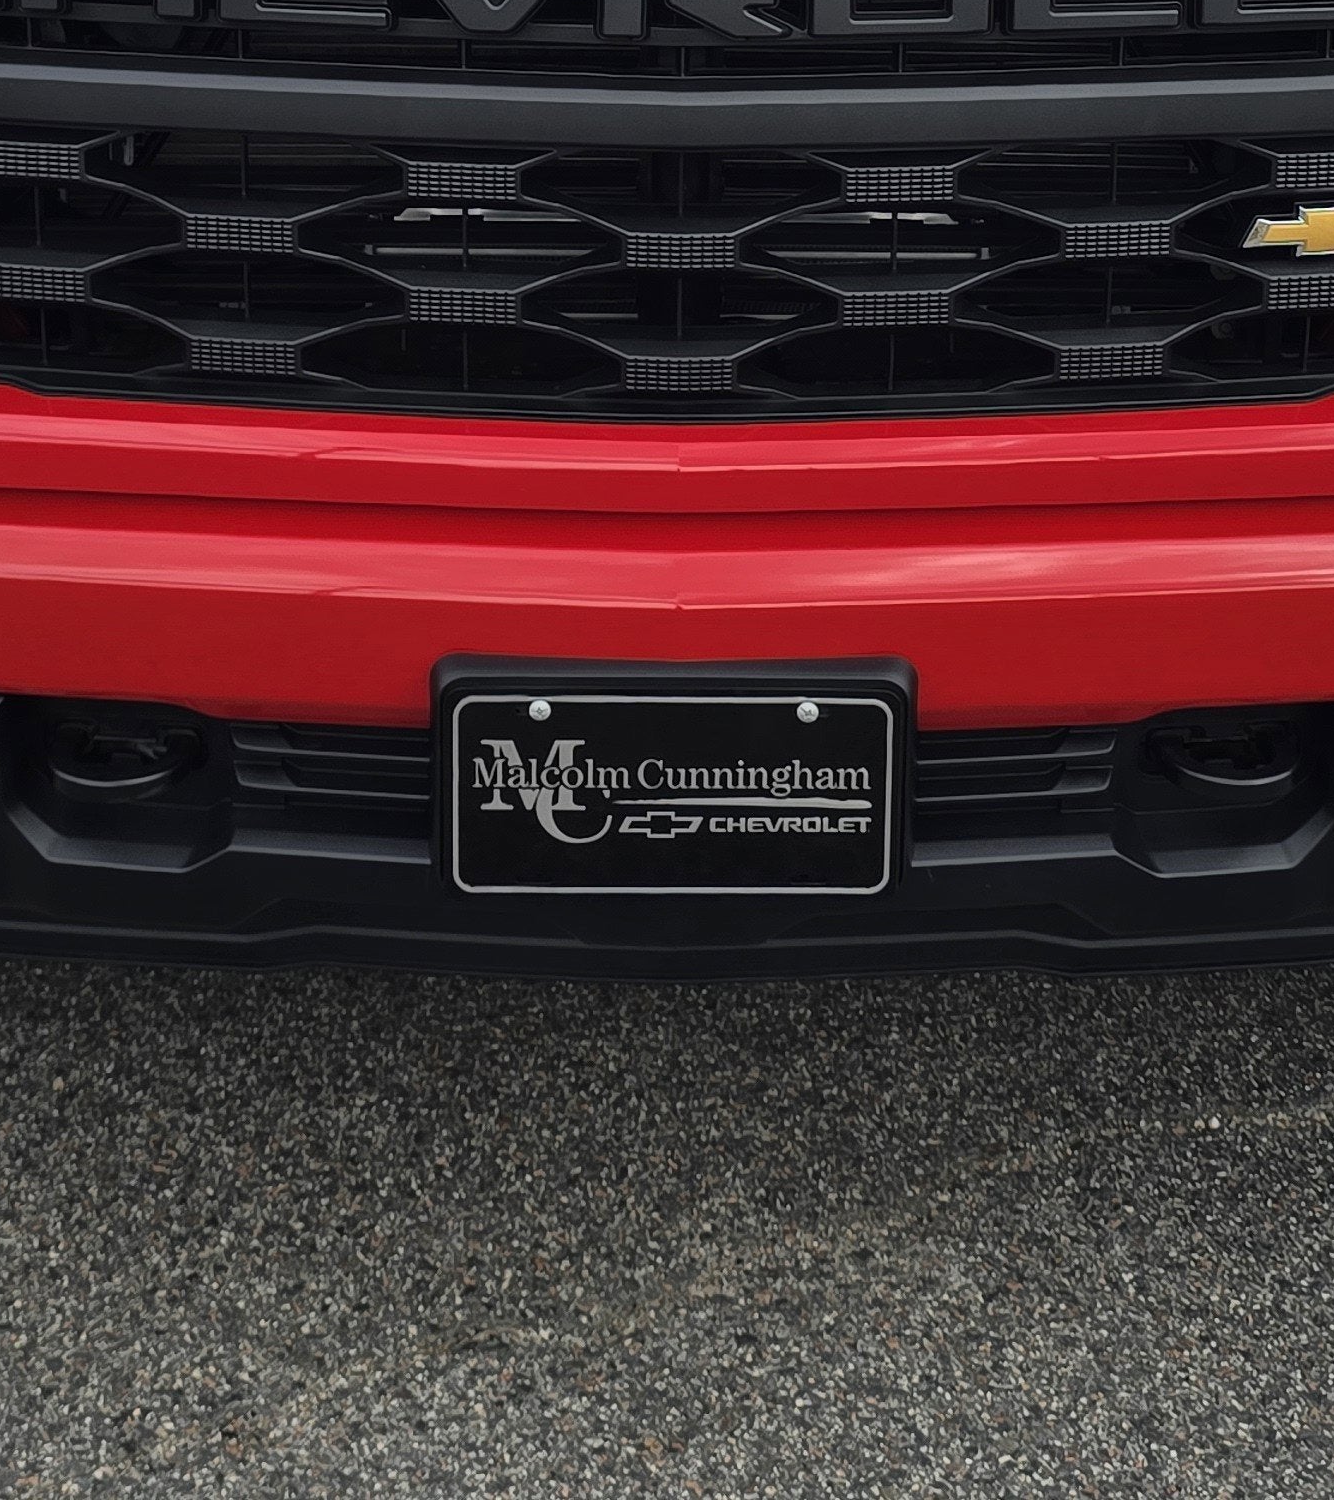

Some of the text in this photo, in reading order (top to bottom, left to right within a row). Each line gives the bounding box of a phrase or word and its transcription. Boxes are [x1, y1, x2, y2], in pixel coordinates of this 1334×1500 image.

[472, 756, 872, 797] Malcolm Cunningham
[709, 816, 872, 834] CHEVROLET
